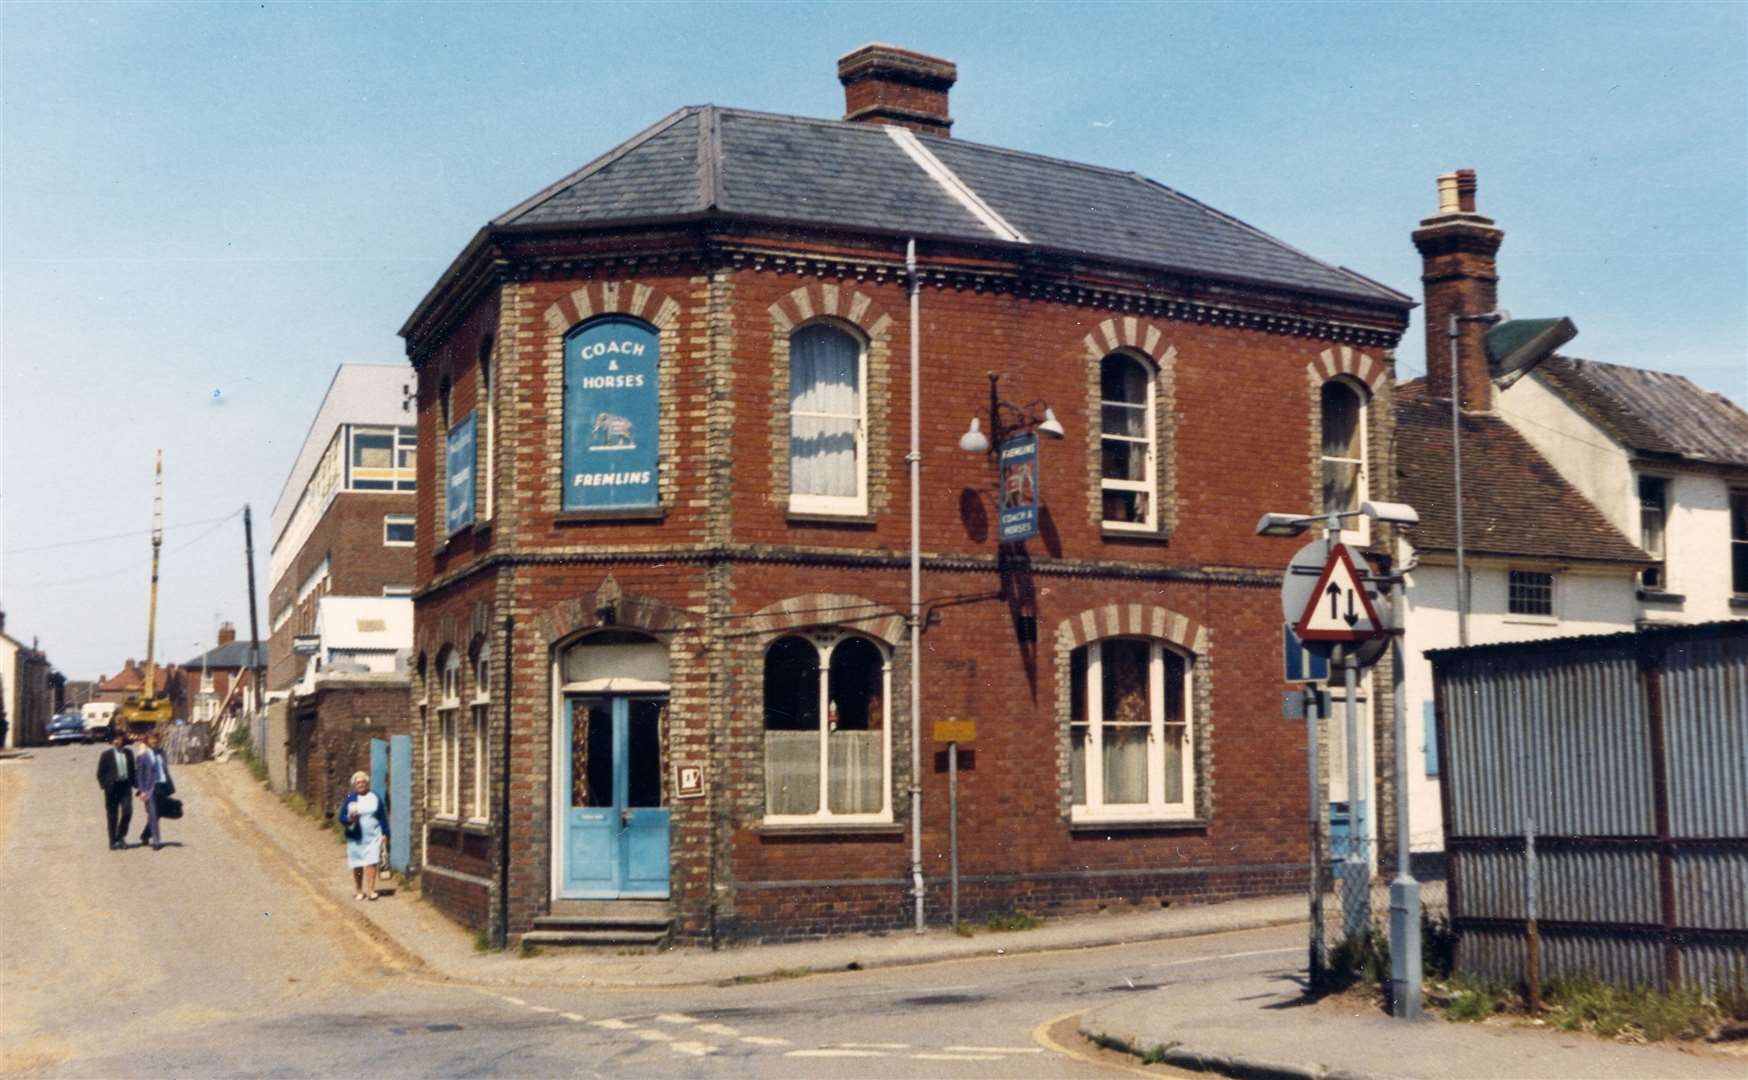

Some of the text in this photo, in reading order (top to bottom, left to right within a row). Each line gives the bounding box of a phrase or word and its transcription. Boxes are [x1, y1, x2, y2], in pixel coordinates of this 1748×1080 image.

[581, 341, 645, 360] COACH
[608, 360, 619, 371] &
[583, 374, 645, 389] HORSES
[574, 471, 651, 487] FREMLINS
[1002, 512, 1025, 523] COACH
[1004, 522, 1031, 534] HORSES
